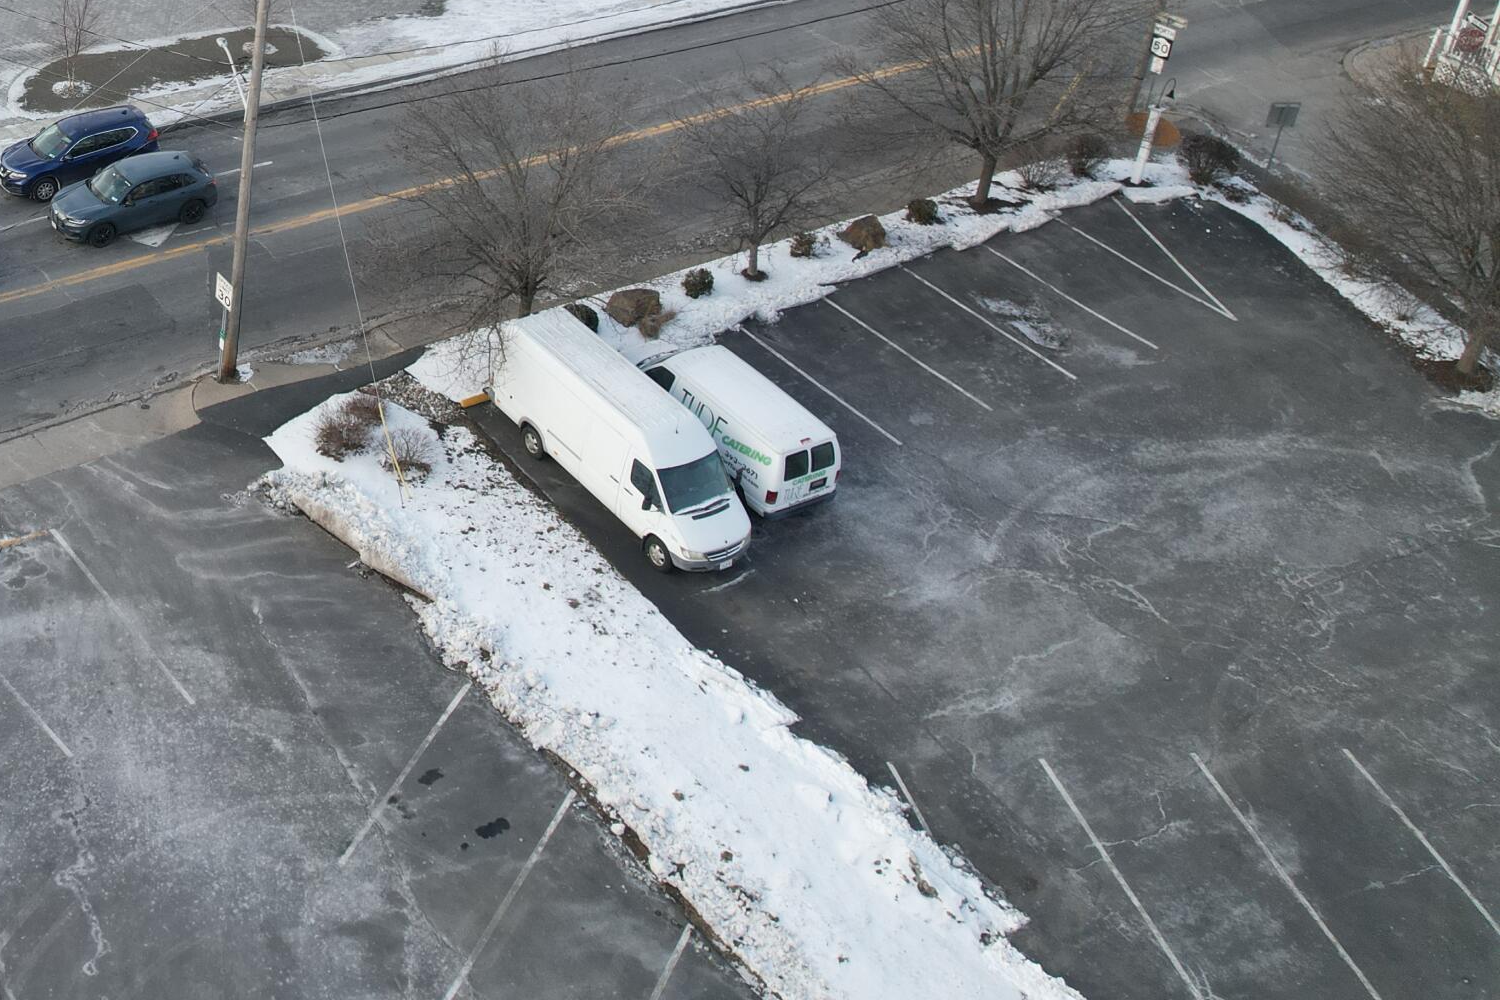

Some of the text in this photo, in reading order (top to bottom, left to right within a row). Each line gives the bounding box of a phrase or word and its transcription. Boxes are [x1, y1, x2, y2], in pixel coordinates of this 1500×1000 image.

[1153, 40, 1169, 54] 50
[218, 289, 231, 307] 30
[722, 435, 772, 466] CATERING
[792, 470, 827, 485] CATERING
